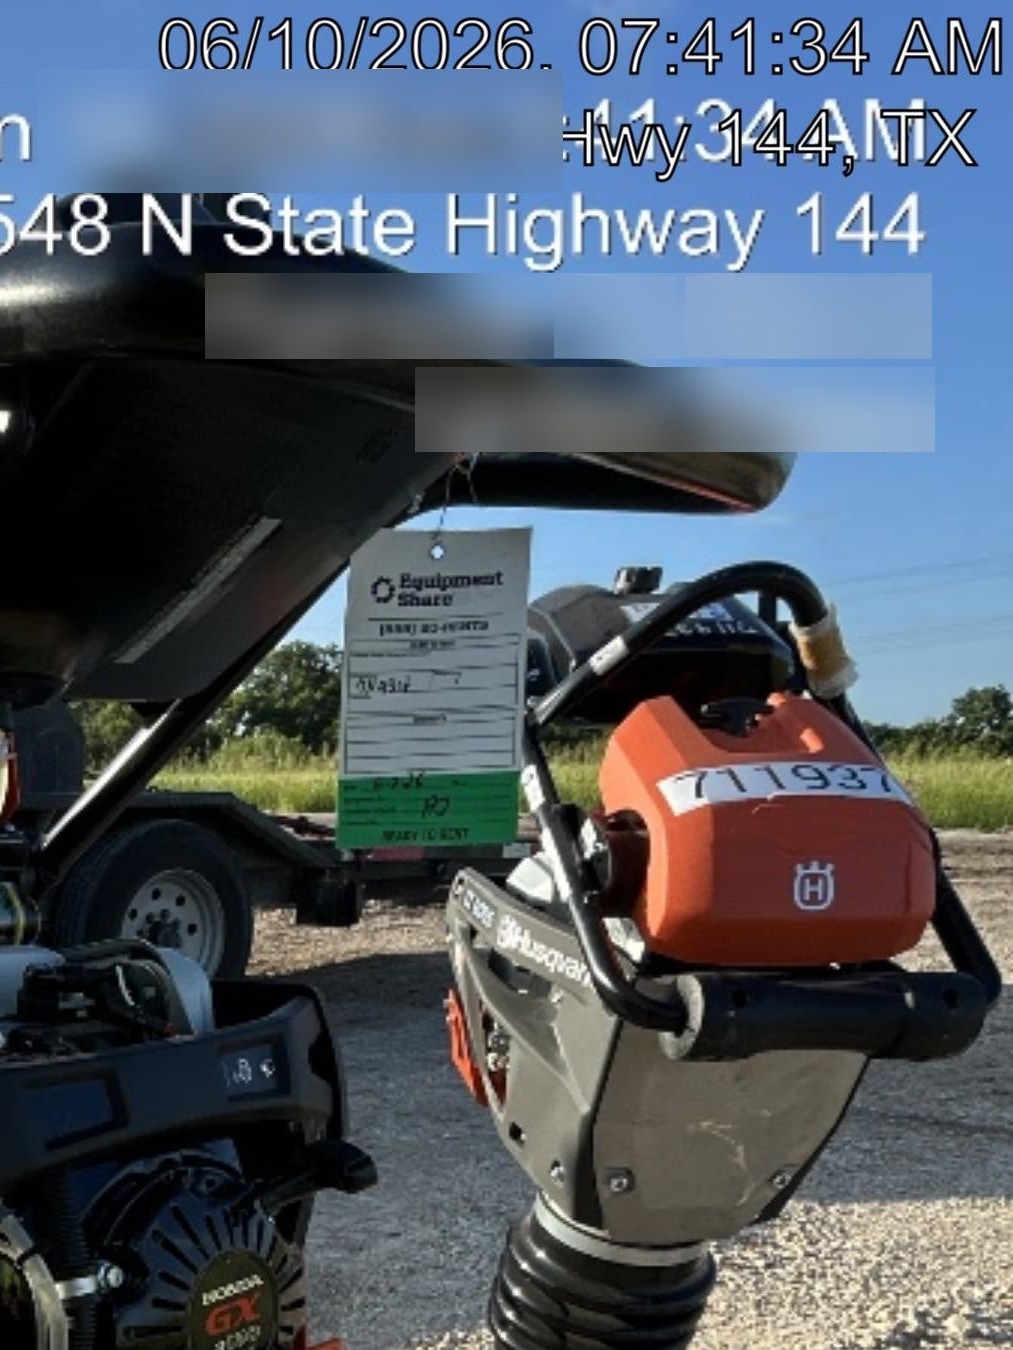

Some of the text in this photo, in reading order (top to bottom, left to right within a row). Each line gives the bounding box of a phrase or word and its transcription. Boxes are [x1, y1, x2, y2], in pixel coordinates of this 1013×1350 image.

[398, 571, 504, 592] Equipment
[397, 592, 454, 608] Share
[674, 763, 892, 799] 711937
[516, 928, 593, 988] Husqvar
